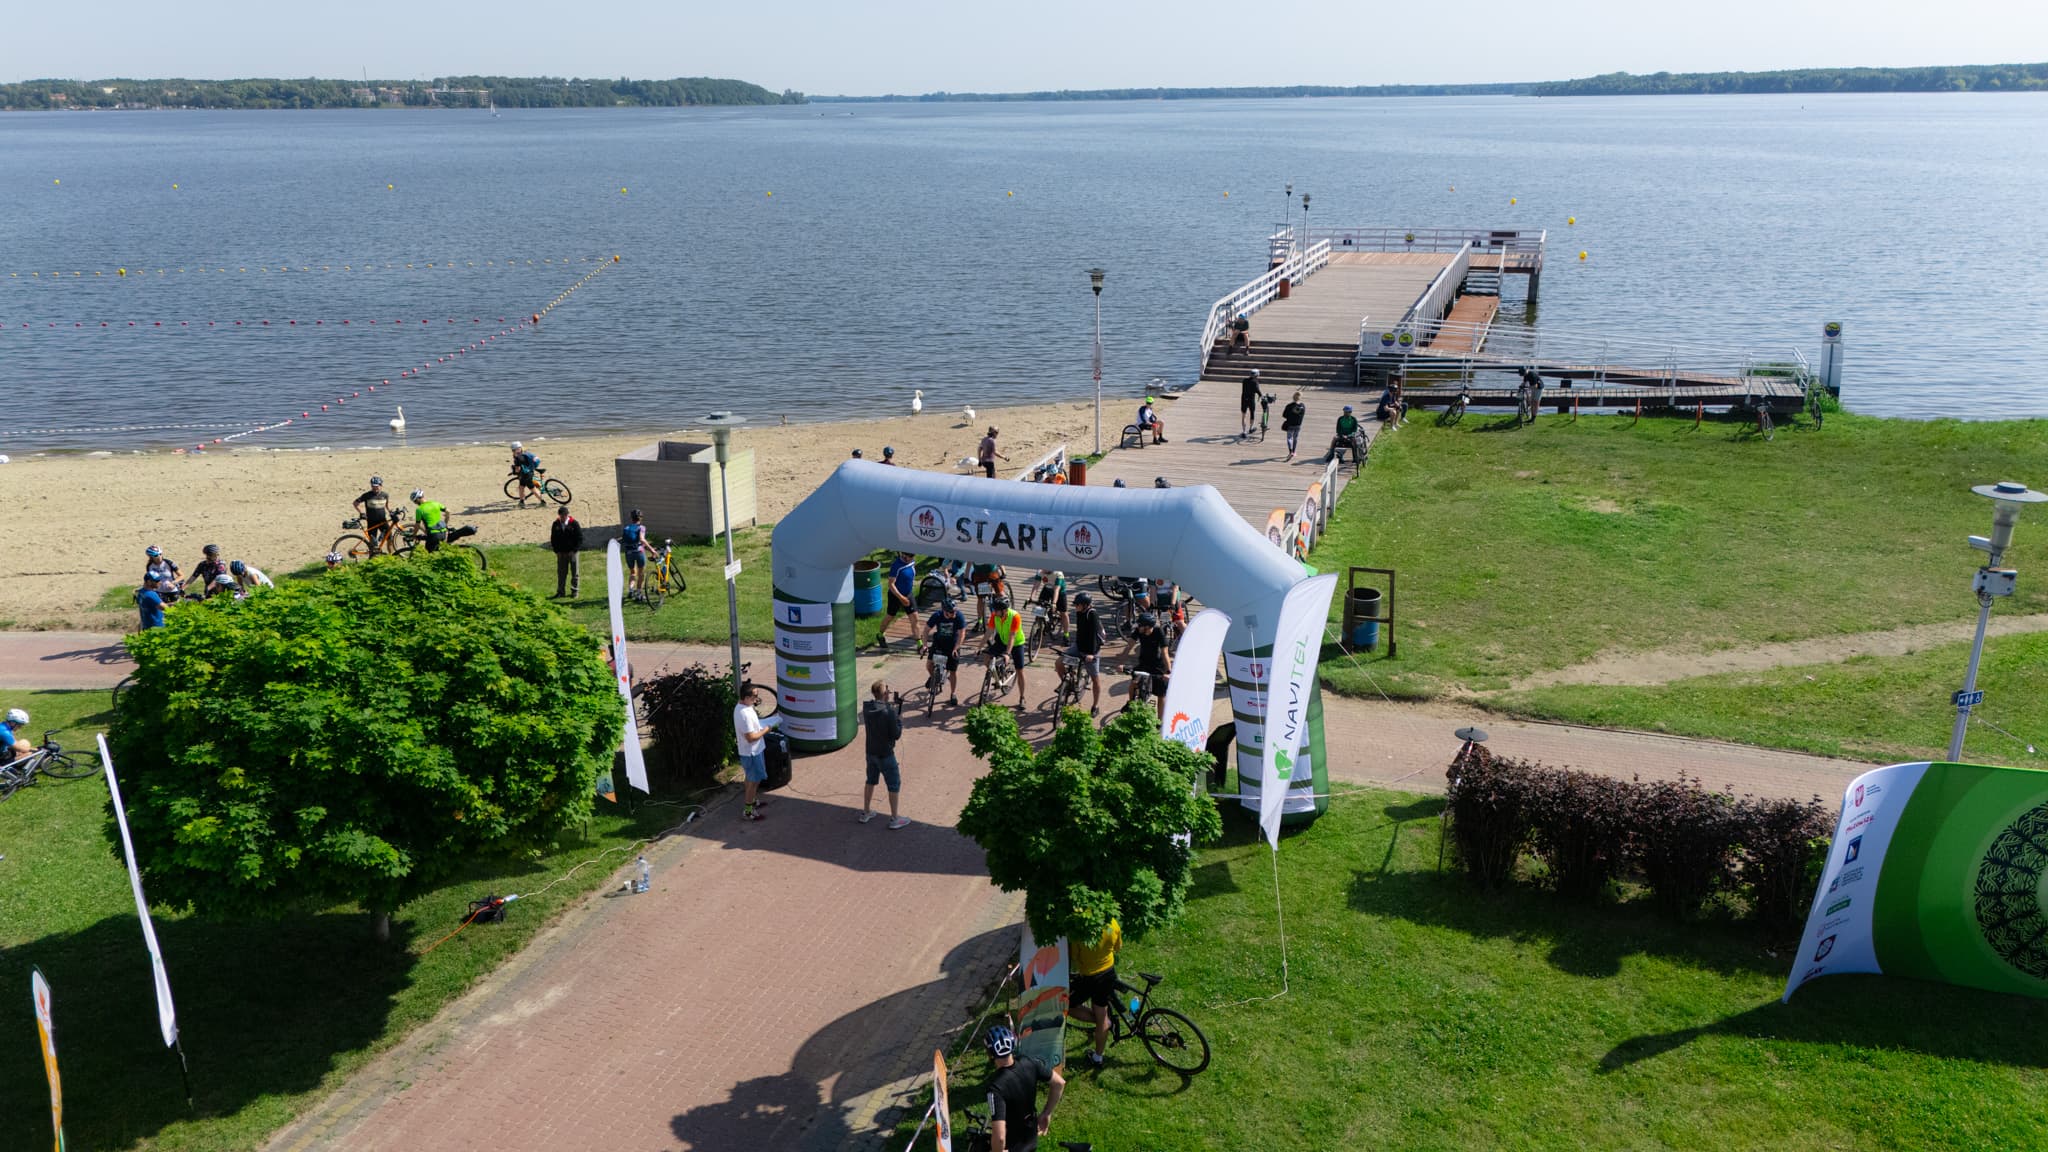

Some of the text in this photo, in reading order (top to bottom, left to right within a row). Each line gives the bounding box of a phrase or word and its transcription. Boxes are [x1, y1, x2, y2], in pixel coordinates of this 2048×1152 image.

[919, 527, 936, 538] MG
[955, 516, 1053, 552] START
[1075, 546, 1093, 556] MG
[1284, 634, 1309, 741] NAVITEL
